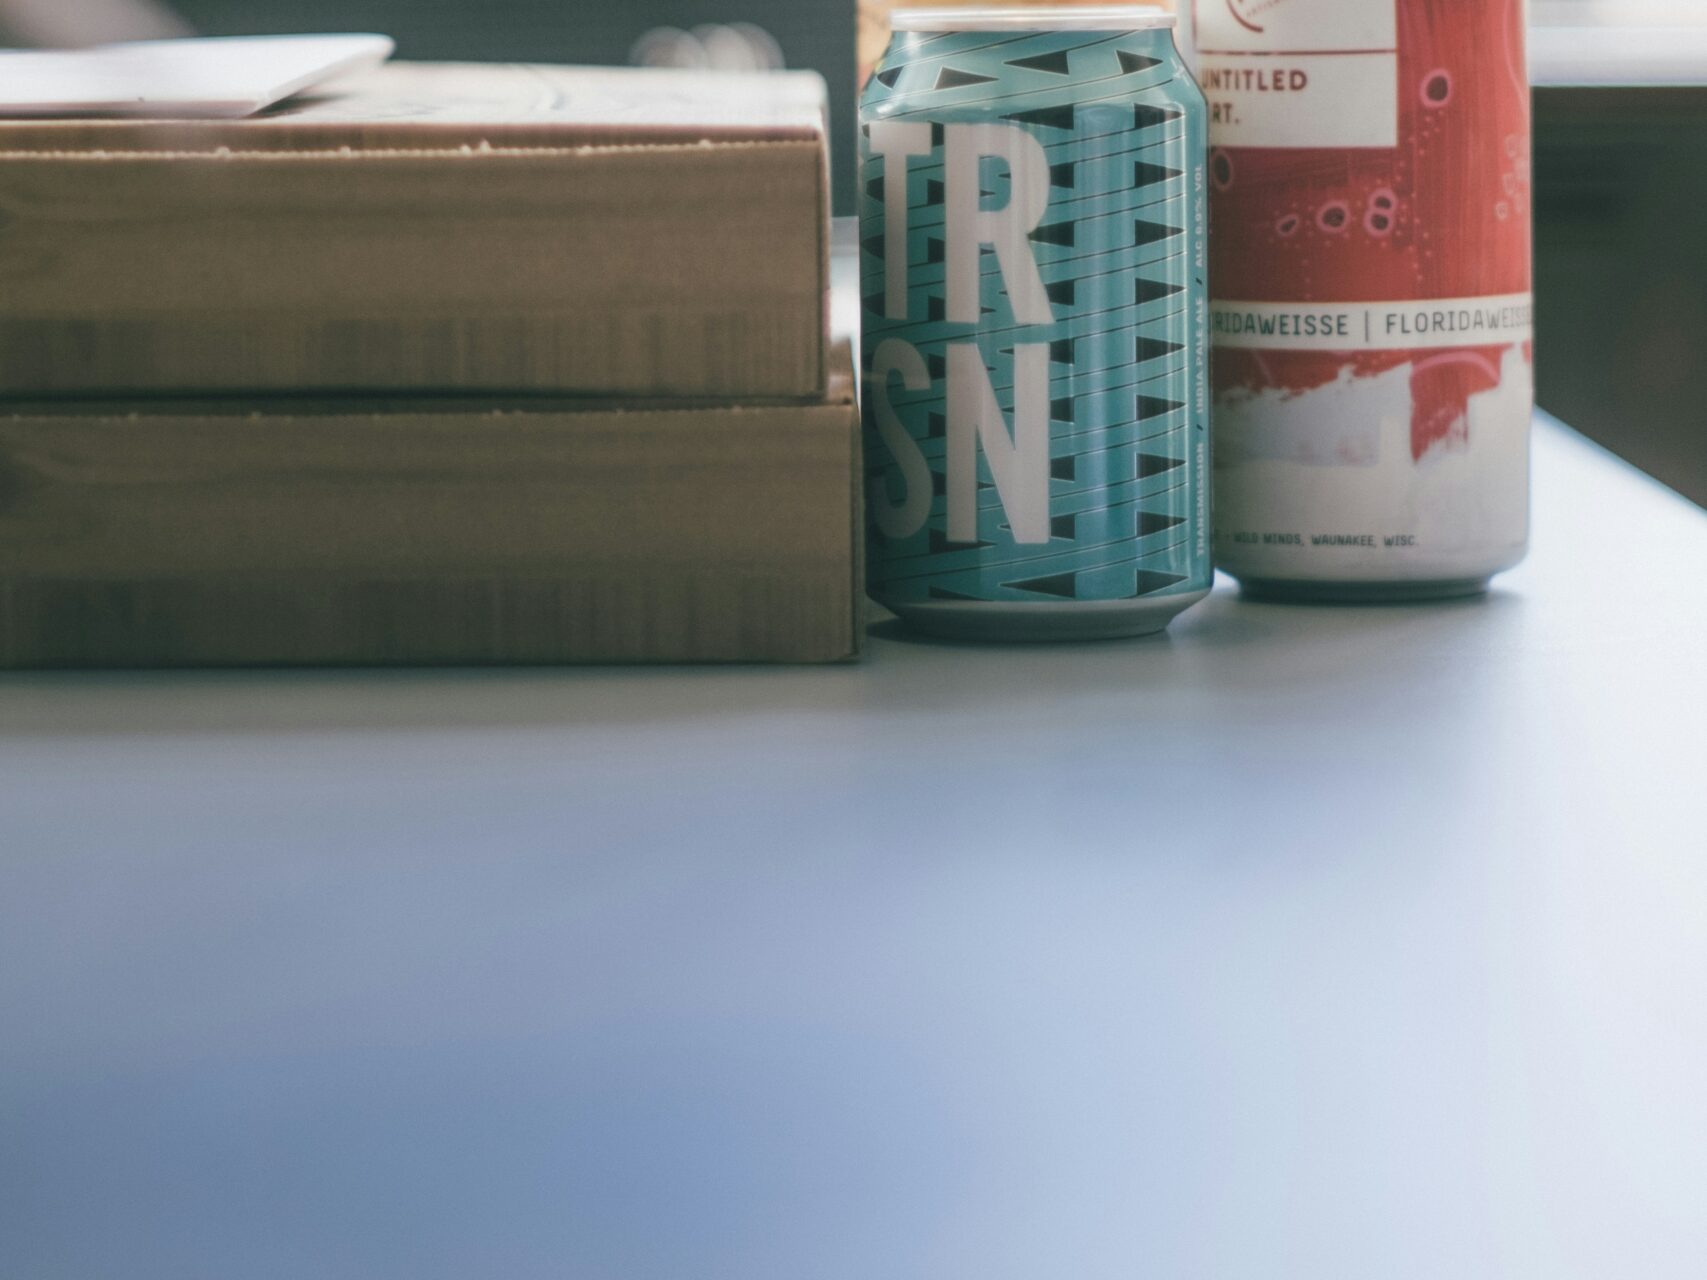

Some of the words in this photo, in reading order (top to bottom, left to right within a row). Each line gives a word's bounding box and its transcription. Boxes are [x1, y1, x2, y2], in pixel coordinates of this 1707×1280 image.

[1211, 103, 1240, 123] RT.
[1194, 240, 1203, 268] ALC
[1195, 296, 1203, 324] ALE
[1195, 328, 1203, 366] PALE
[1195, 370, 1204, 414] INDIA
[1196, 442, 1204, 558] TRANSMISSION
